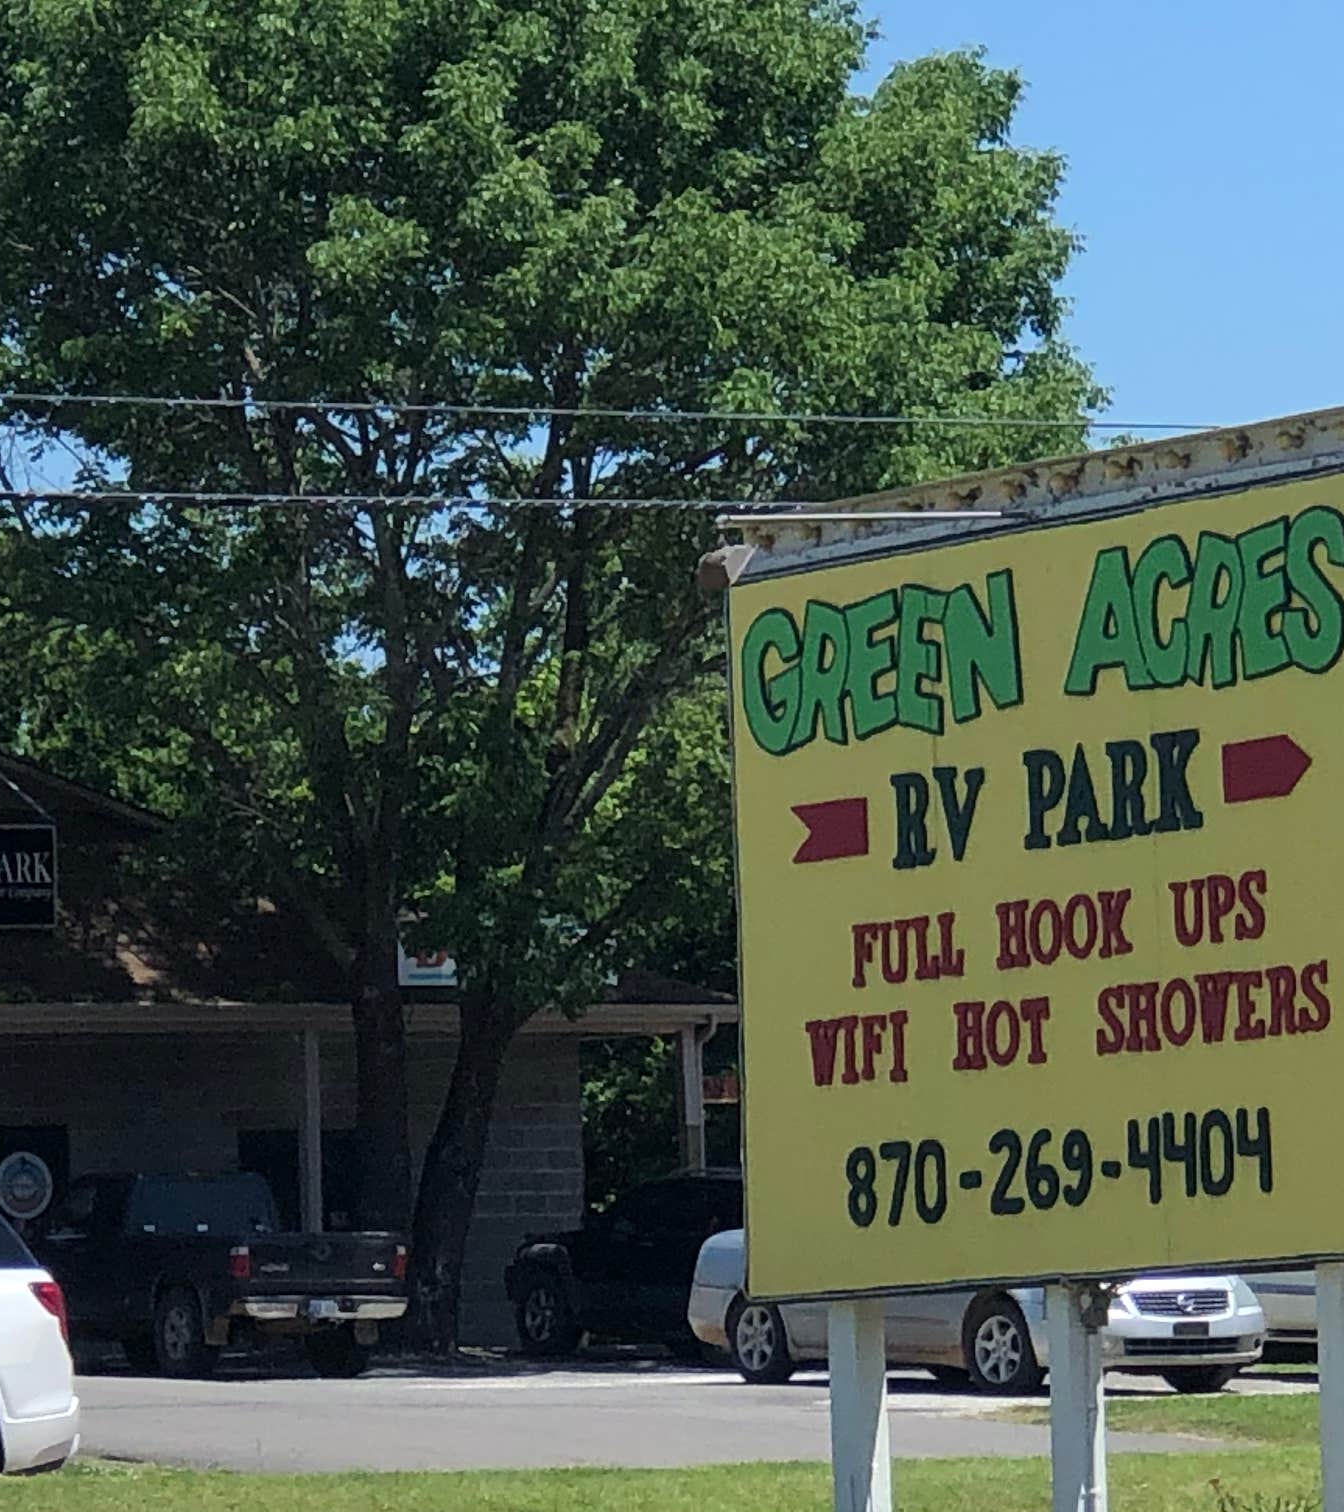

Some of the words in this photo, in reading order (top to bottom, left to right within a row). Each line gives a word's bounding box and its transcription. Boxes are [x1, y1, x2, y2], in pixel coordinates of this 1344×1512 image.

[741, 568, 1024, 756] GREEN
[889, 767, 985, 870] RV
[1023, 729, 1203, 851] PARK
[852, 911, 965, 988] FULL
[996, 888, 1134, 970] HOOK
[1168, 870, 1268, 948] UPS
[806, 1009, 908, 1087] WIFI
[953, 997, 1050, 1071] HOT
[1096, 960, 1331, 1057] SHOWERS
[845, 1107, 1274, 1229] 870-269-4404
